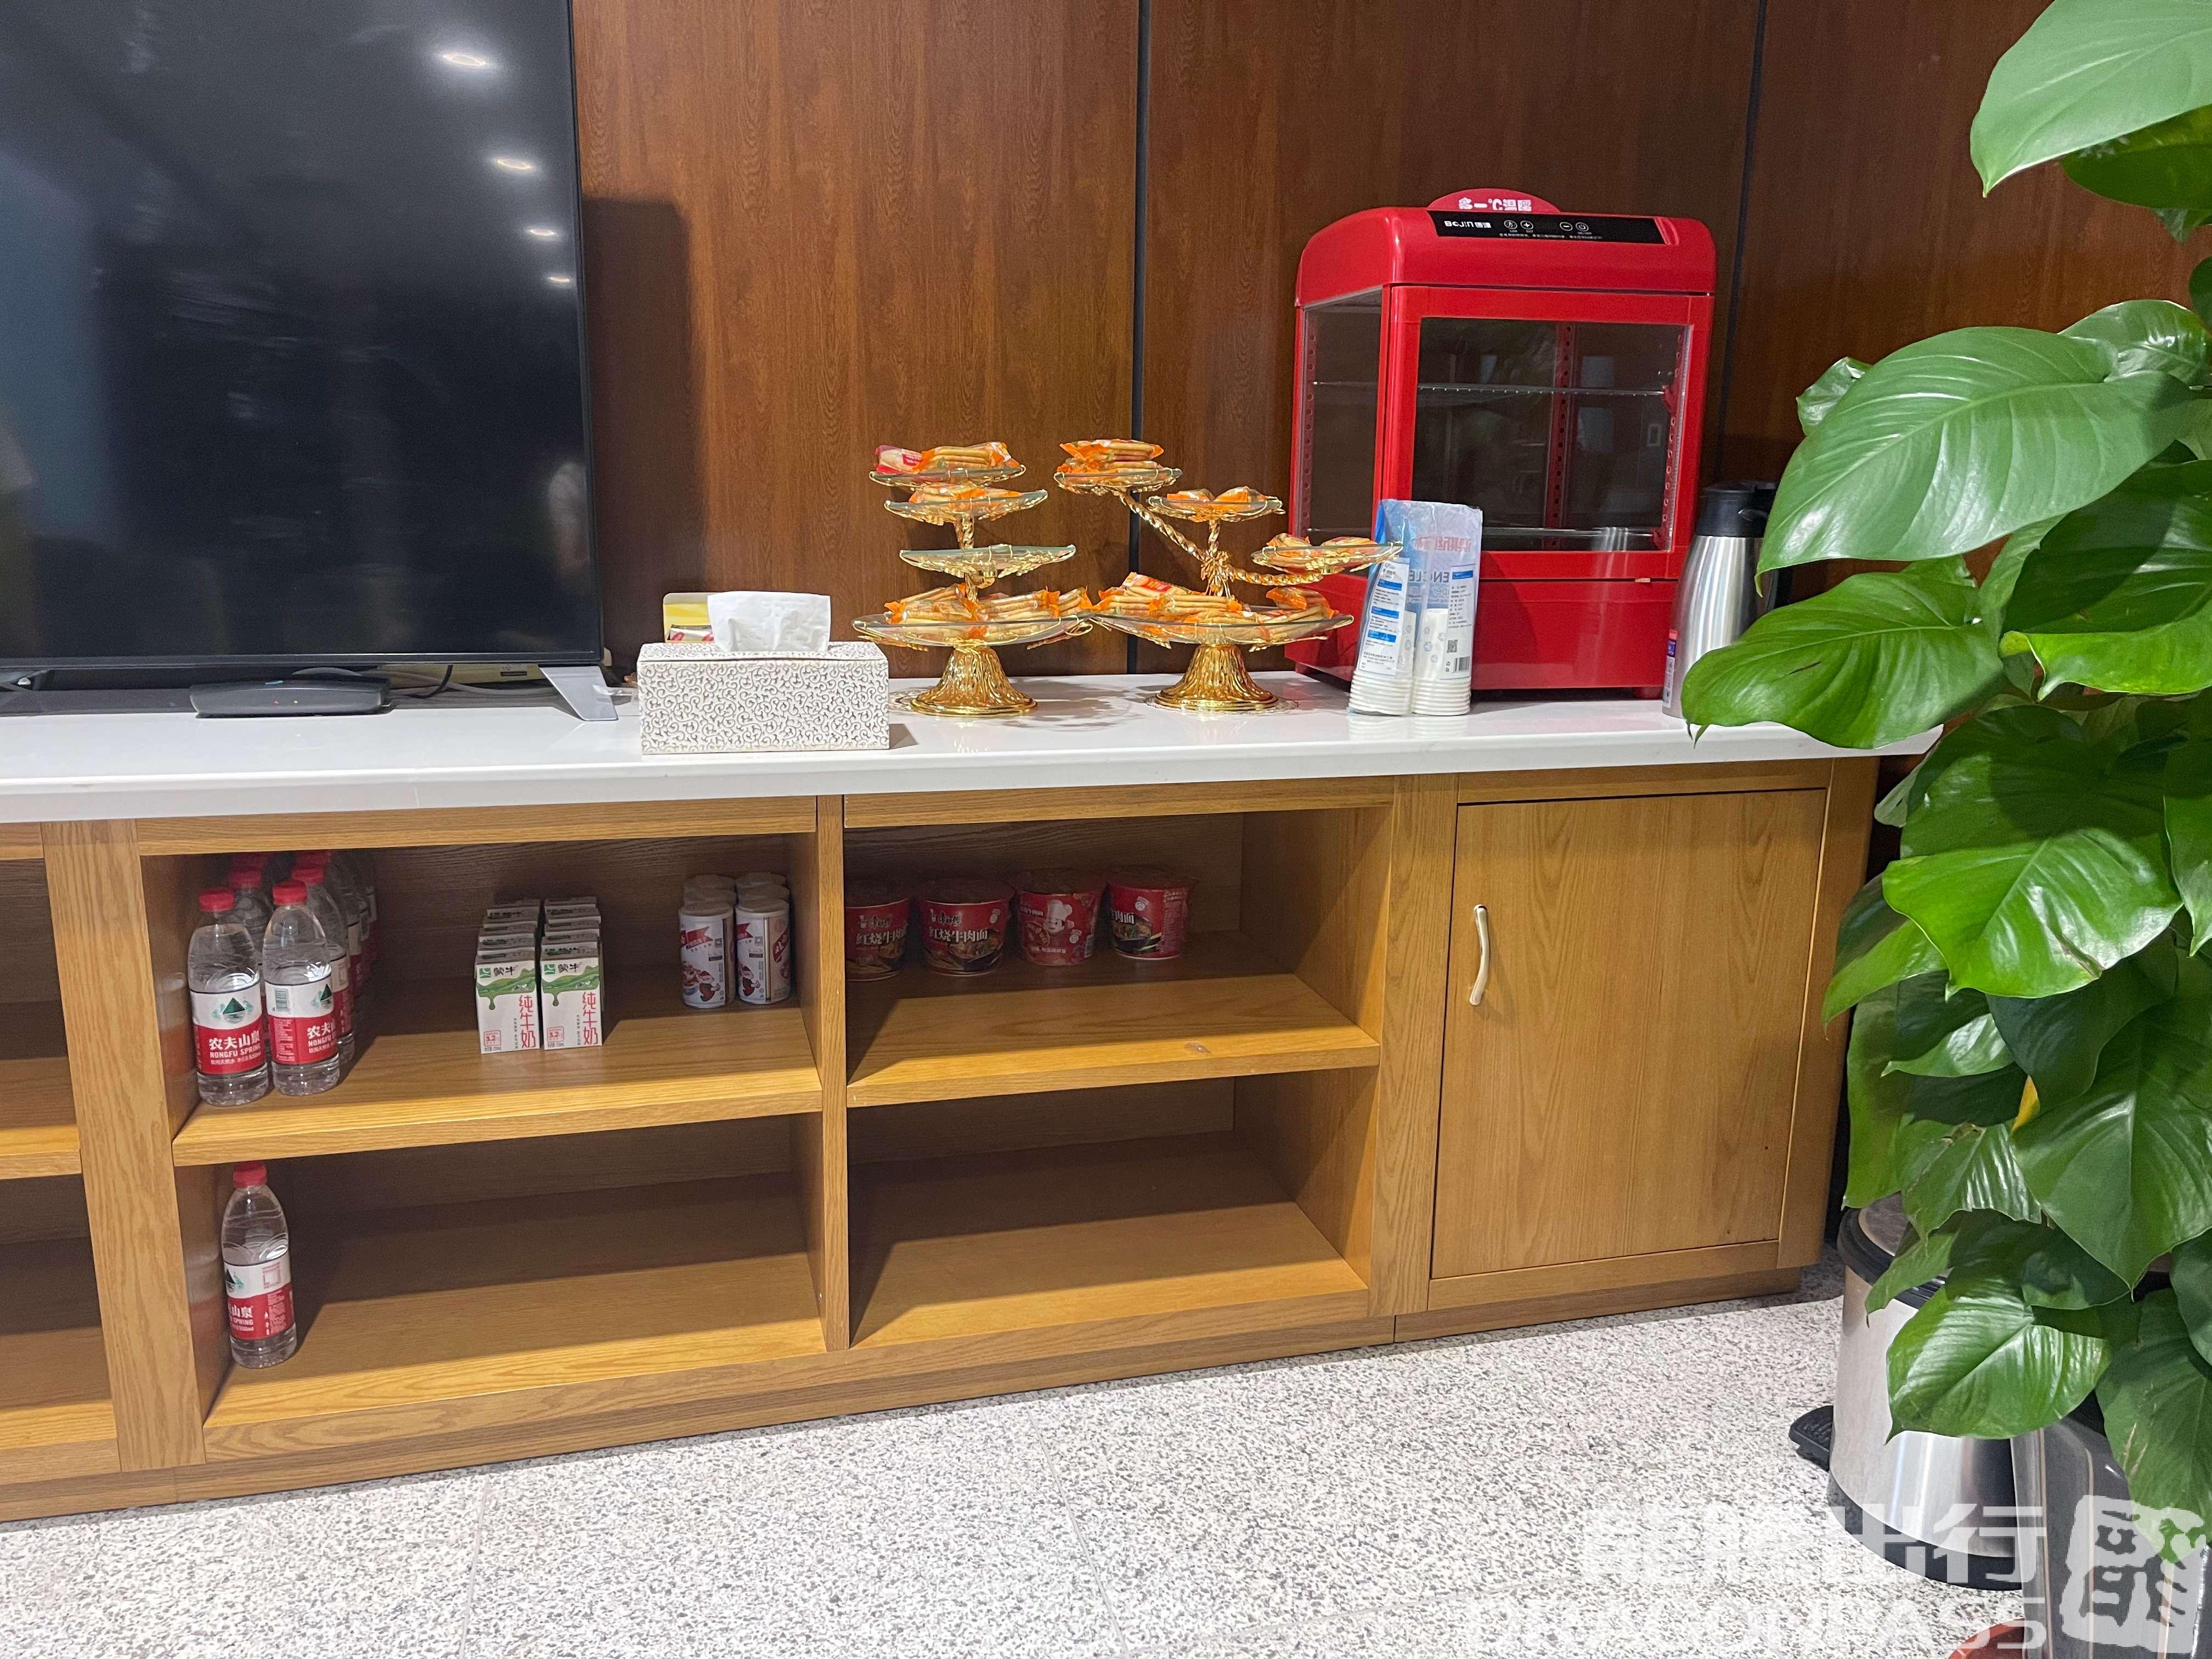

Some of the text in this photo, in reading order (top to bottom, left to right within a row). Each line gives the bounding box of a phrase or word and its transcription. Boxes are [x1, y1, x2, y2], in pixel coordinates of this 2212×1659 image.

[929, 926, 988, 943] 红烧牛肉面
[519, 995, 536, 1048] 纯牛奶
[582, 991, 598, 1045] 纯牛奶
[208, 1030, 261, 1051] 农夫山泉
[210, 1050, 238, 1058] NONGFU
